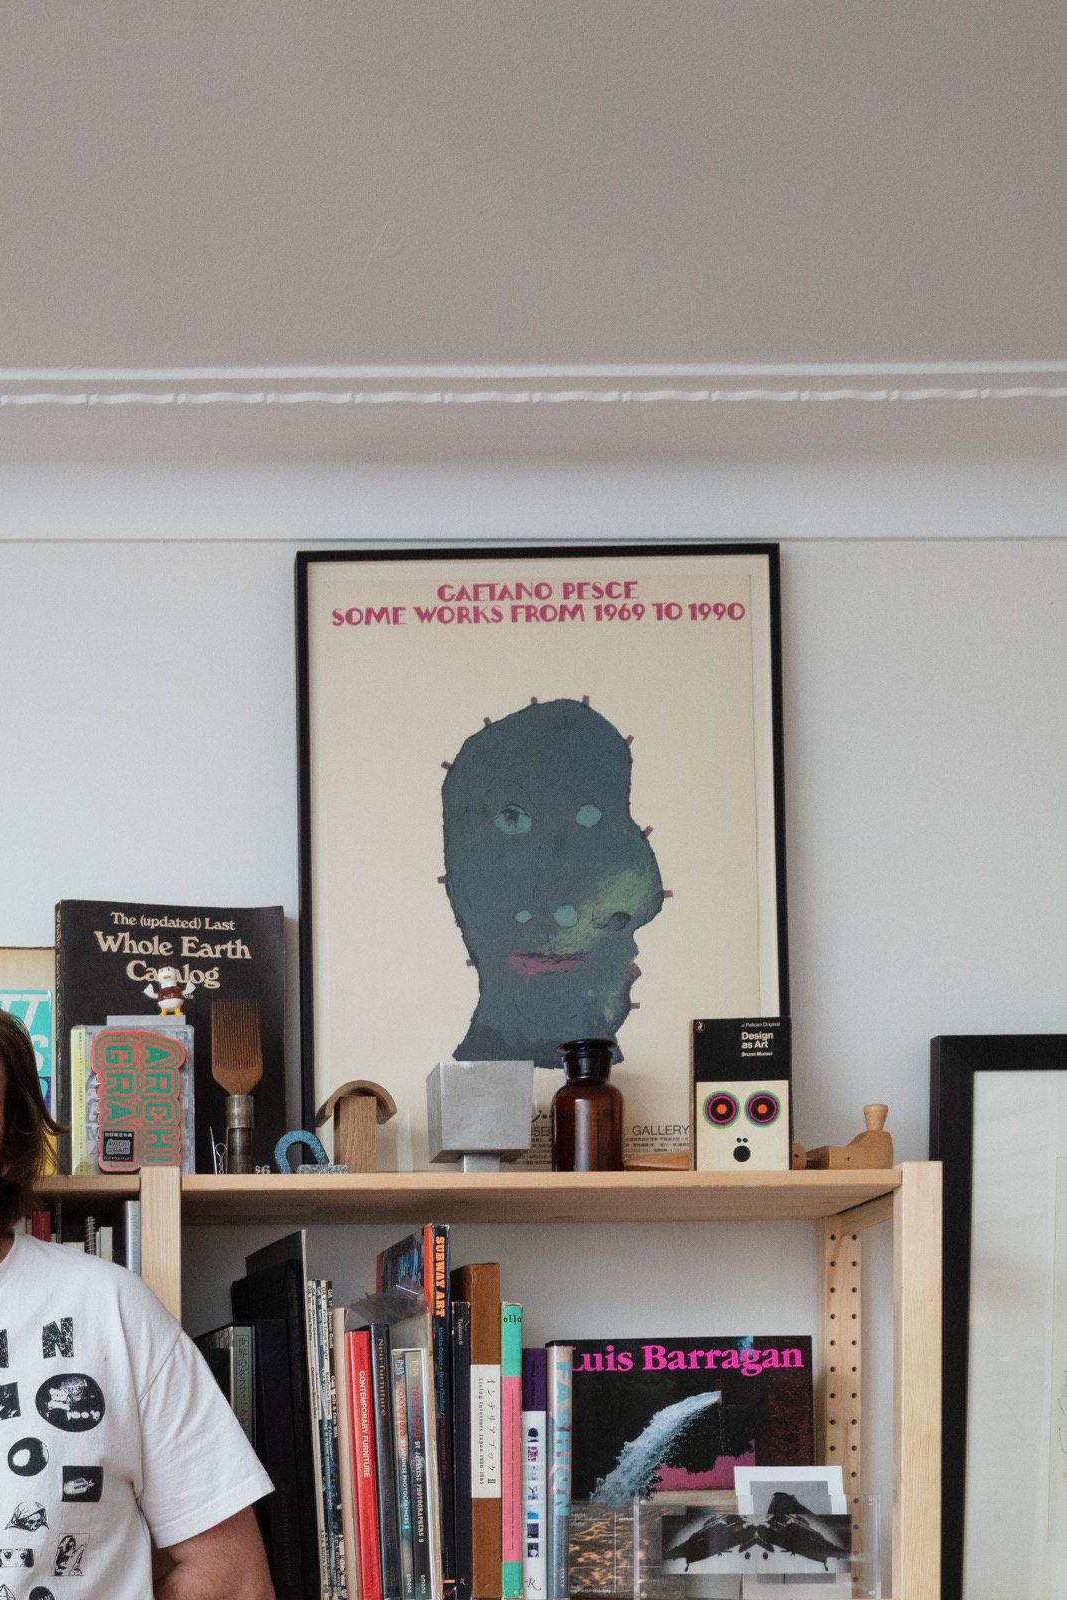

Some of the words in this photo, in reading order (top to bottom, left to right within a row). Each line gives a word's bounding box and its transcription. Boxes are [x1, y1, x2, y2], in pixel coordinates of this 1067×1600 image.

[437, 582, 553, 602] GAETANO
[563, 581, 638, 600] PESCE
[332, 606, 405, 627] SOME
[413, 605, 503, 625] WORKS
[511, 604, 585, 623] FROM
[594, 603, 645, 623] 1969
[652, 602, 682, 621] TO
[688, 602, 746, 621] 1990
[110, 911, 136, 926] The
[140, 914, 202, 930] (updated)
[205, 917, 236, 931] Last
[94, 931, 174, 957] Whole
[181, 935, 252, 960] Earth
[126, 959, 221, 989] Caalog
[741, 1031, 774, 1041] Design
[754, 1041, 769, 1049] Art
[105, 1046, 133, 1121] GRA
[144, 1045, 175, 1164] ARCHI
[632, 1125, 690, 1136] GALLERY
[435, 1236, 445, 1289] SUBWAY
[436, 1292, 446, 1317] ART
[641, 1344, 805, 1377] Barragan
[359, 1370, 369, 1434] CONTEMPORARY
[362, 1435, 371, 1478] FURNITURE
